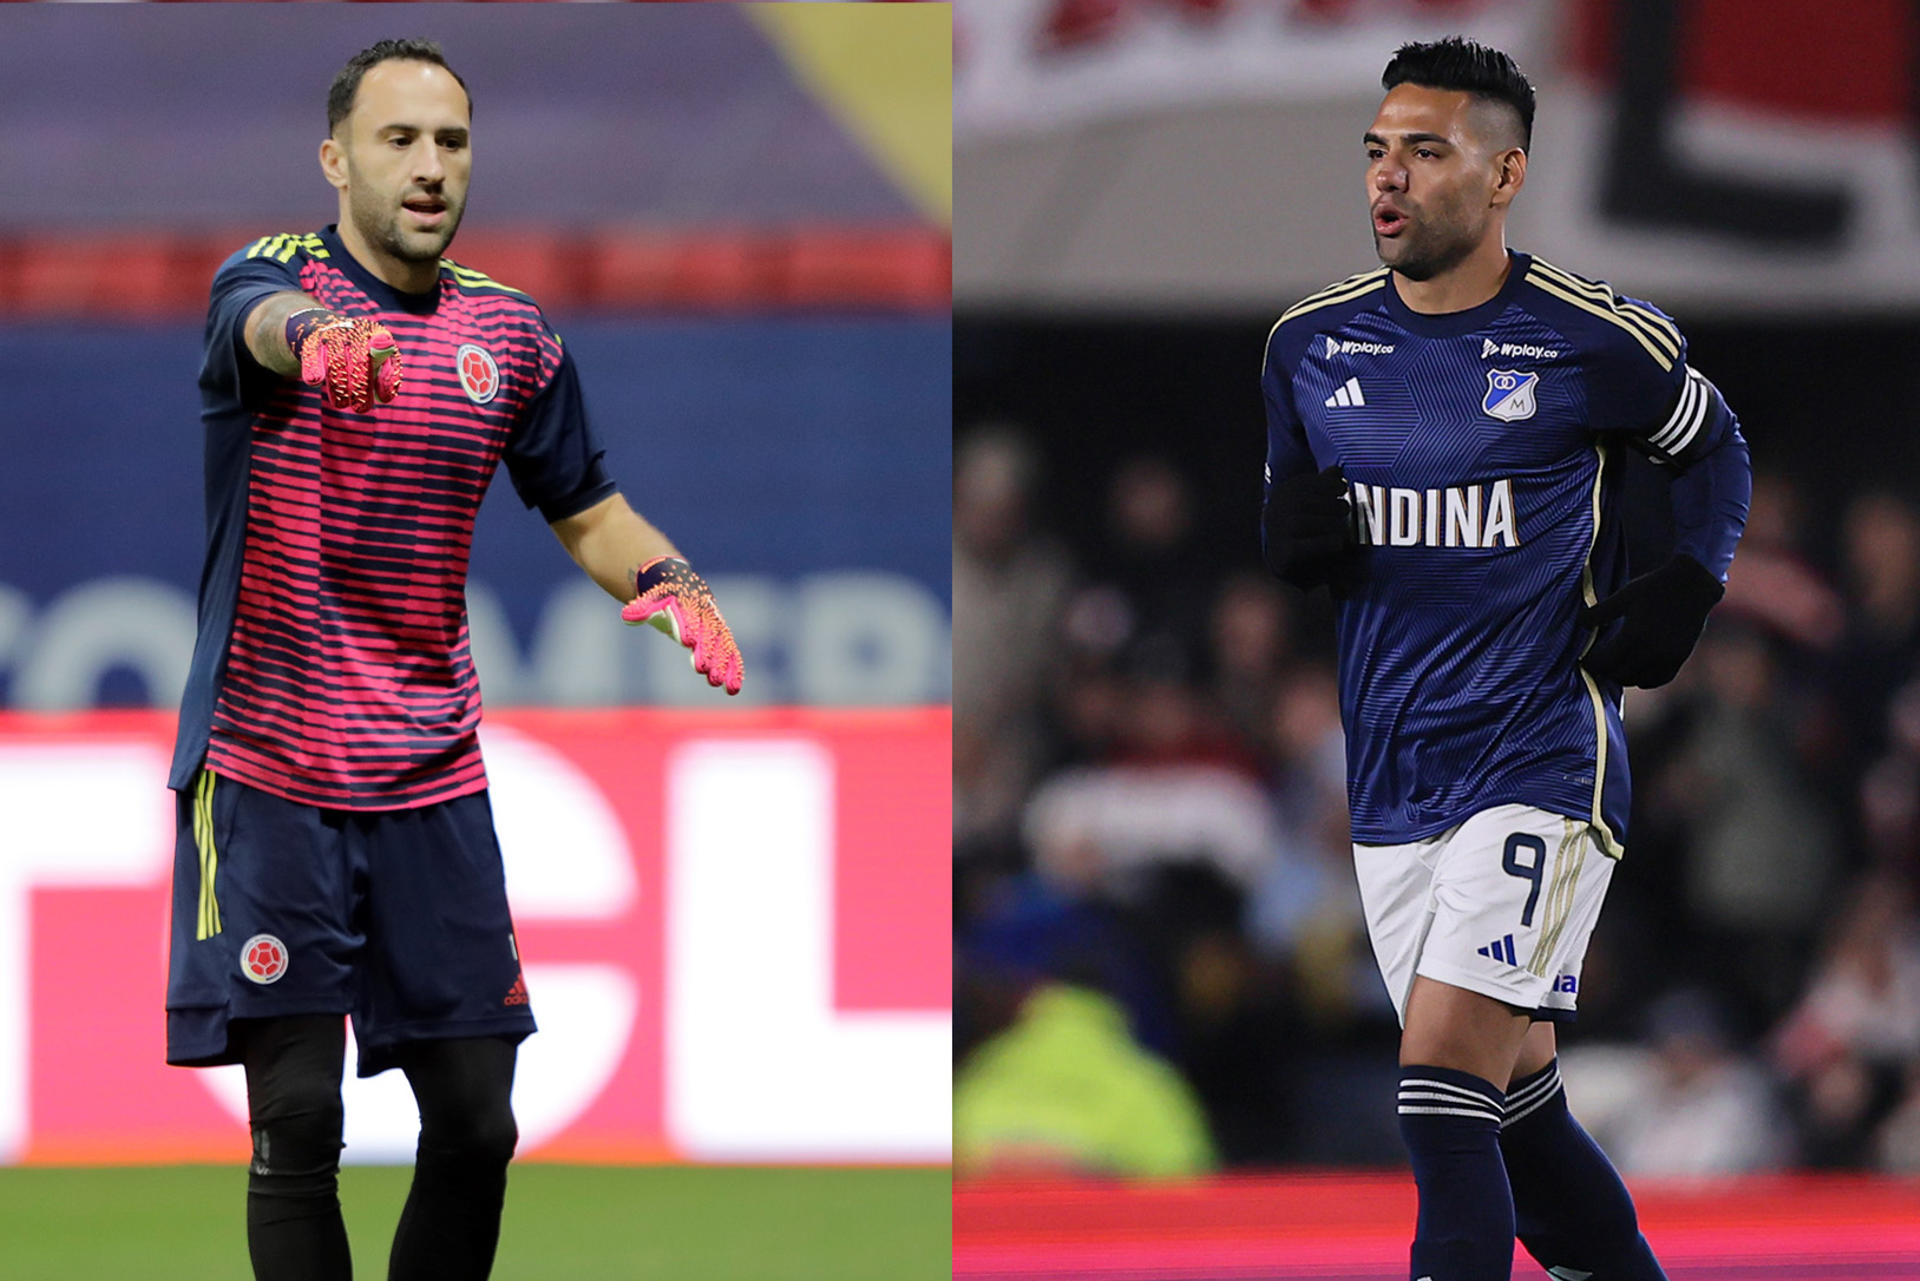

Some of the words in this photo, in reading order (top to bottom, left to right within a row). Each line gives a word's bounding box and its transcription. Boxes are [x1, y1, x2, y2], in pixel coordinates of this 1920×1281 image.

[1501, 343, 1558, 359] Wplay.co
[1510, 398, 1525, 412] M
[1337, 478, 1520, 548] NDINA
[1502, 832, 1546, 927] 9
